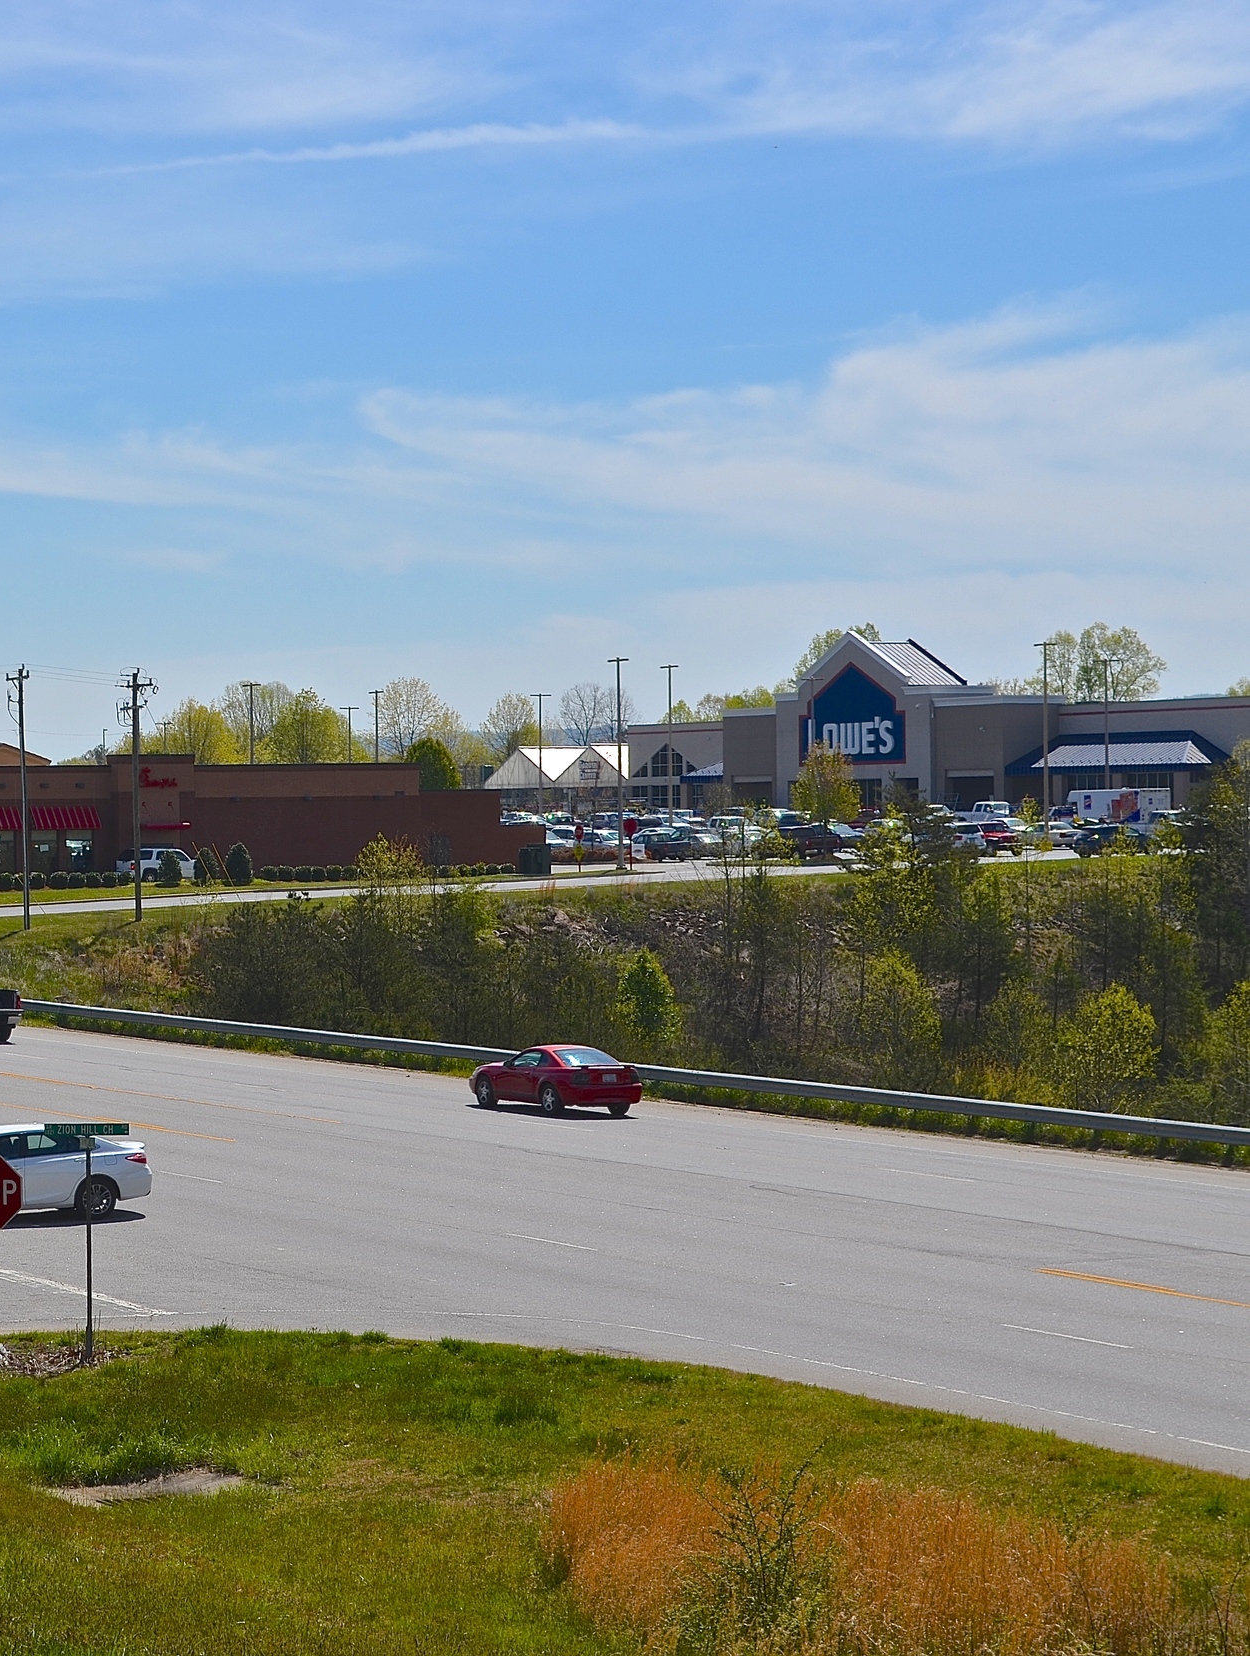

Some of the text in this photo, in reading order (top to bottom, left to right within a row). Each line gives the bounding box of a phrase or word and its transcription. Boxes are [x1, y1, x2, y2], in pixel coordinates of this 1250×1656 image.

[57, 1124, 114, 1135] ZION HILL CH
